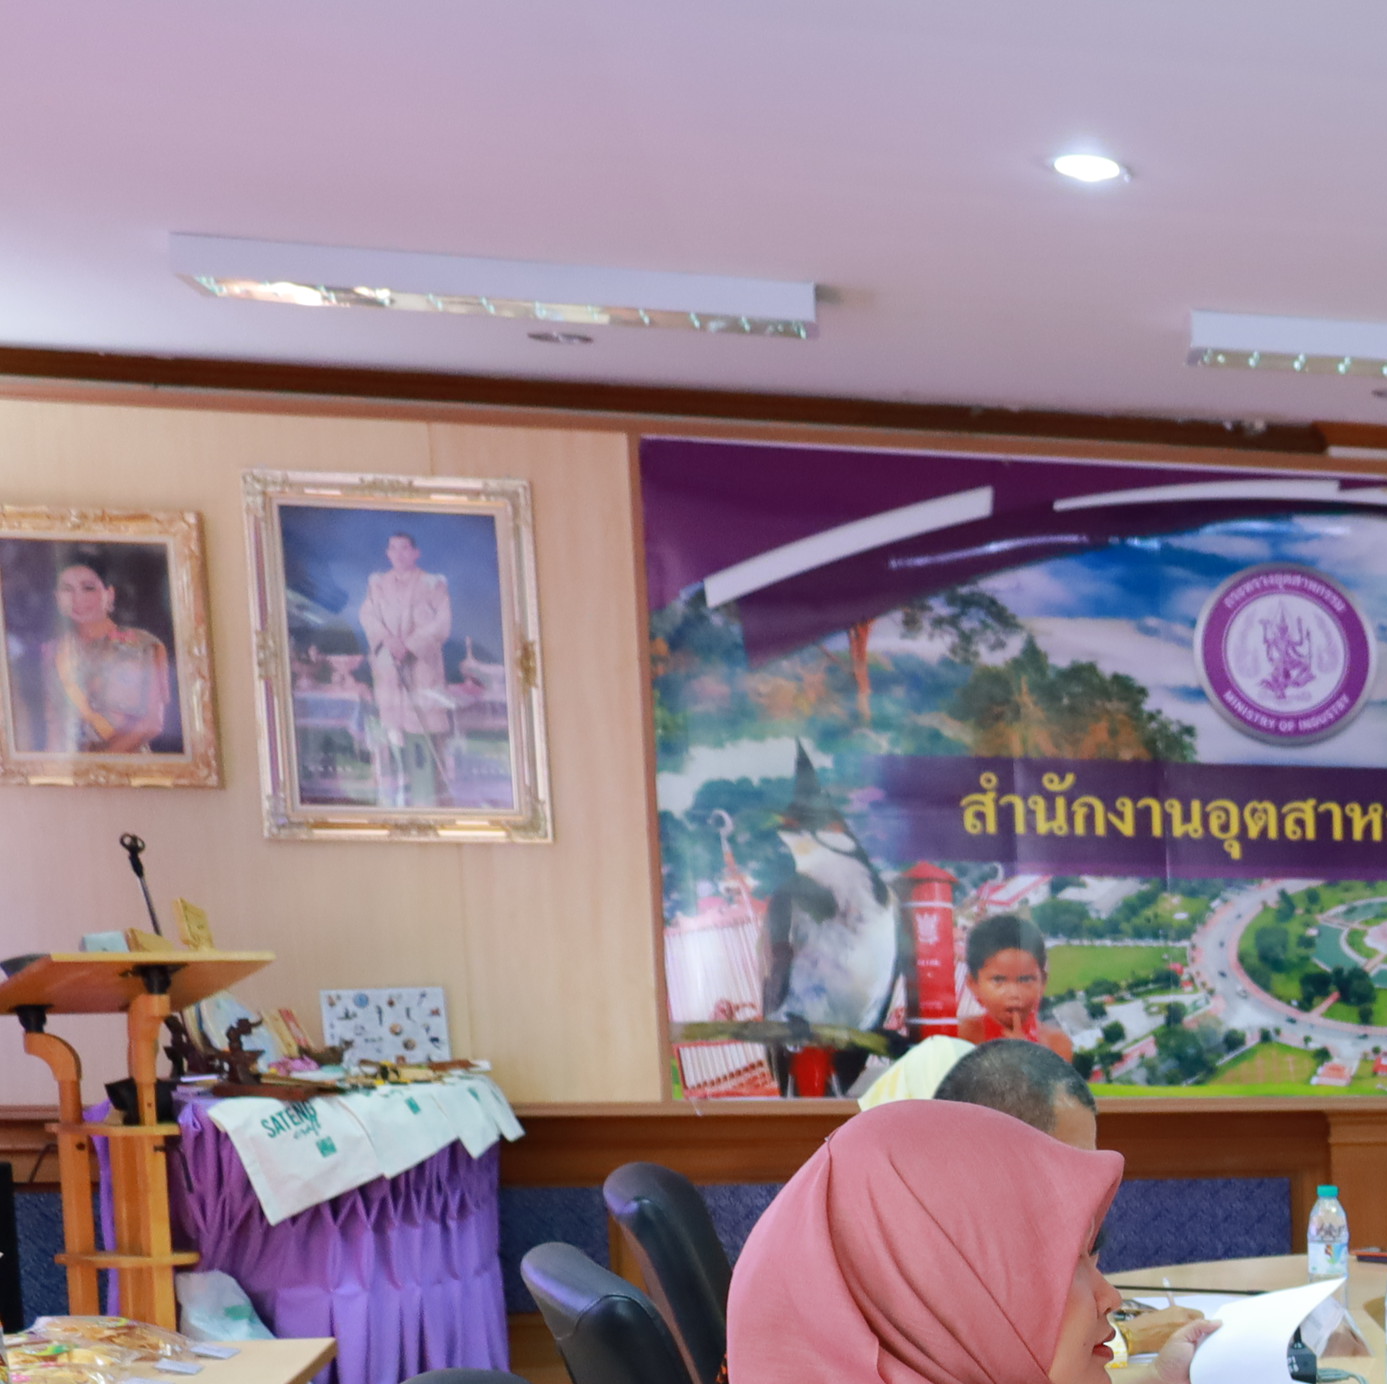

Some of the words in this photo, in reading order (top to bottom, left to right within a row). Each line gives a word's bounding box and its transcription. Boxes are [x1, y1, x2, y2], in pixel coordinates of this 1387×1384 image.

[1222, 690, 1275, 729] MINISTRY
[1279, 720, 1295, 733] OF
[1298, 692, 1350, 731] INDUSTRY
[260, 1100, 317, 1138] SATENG
